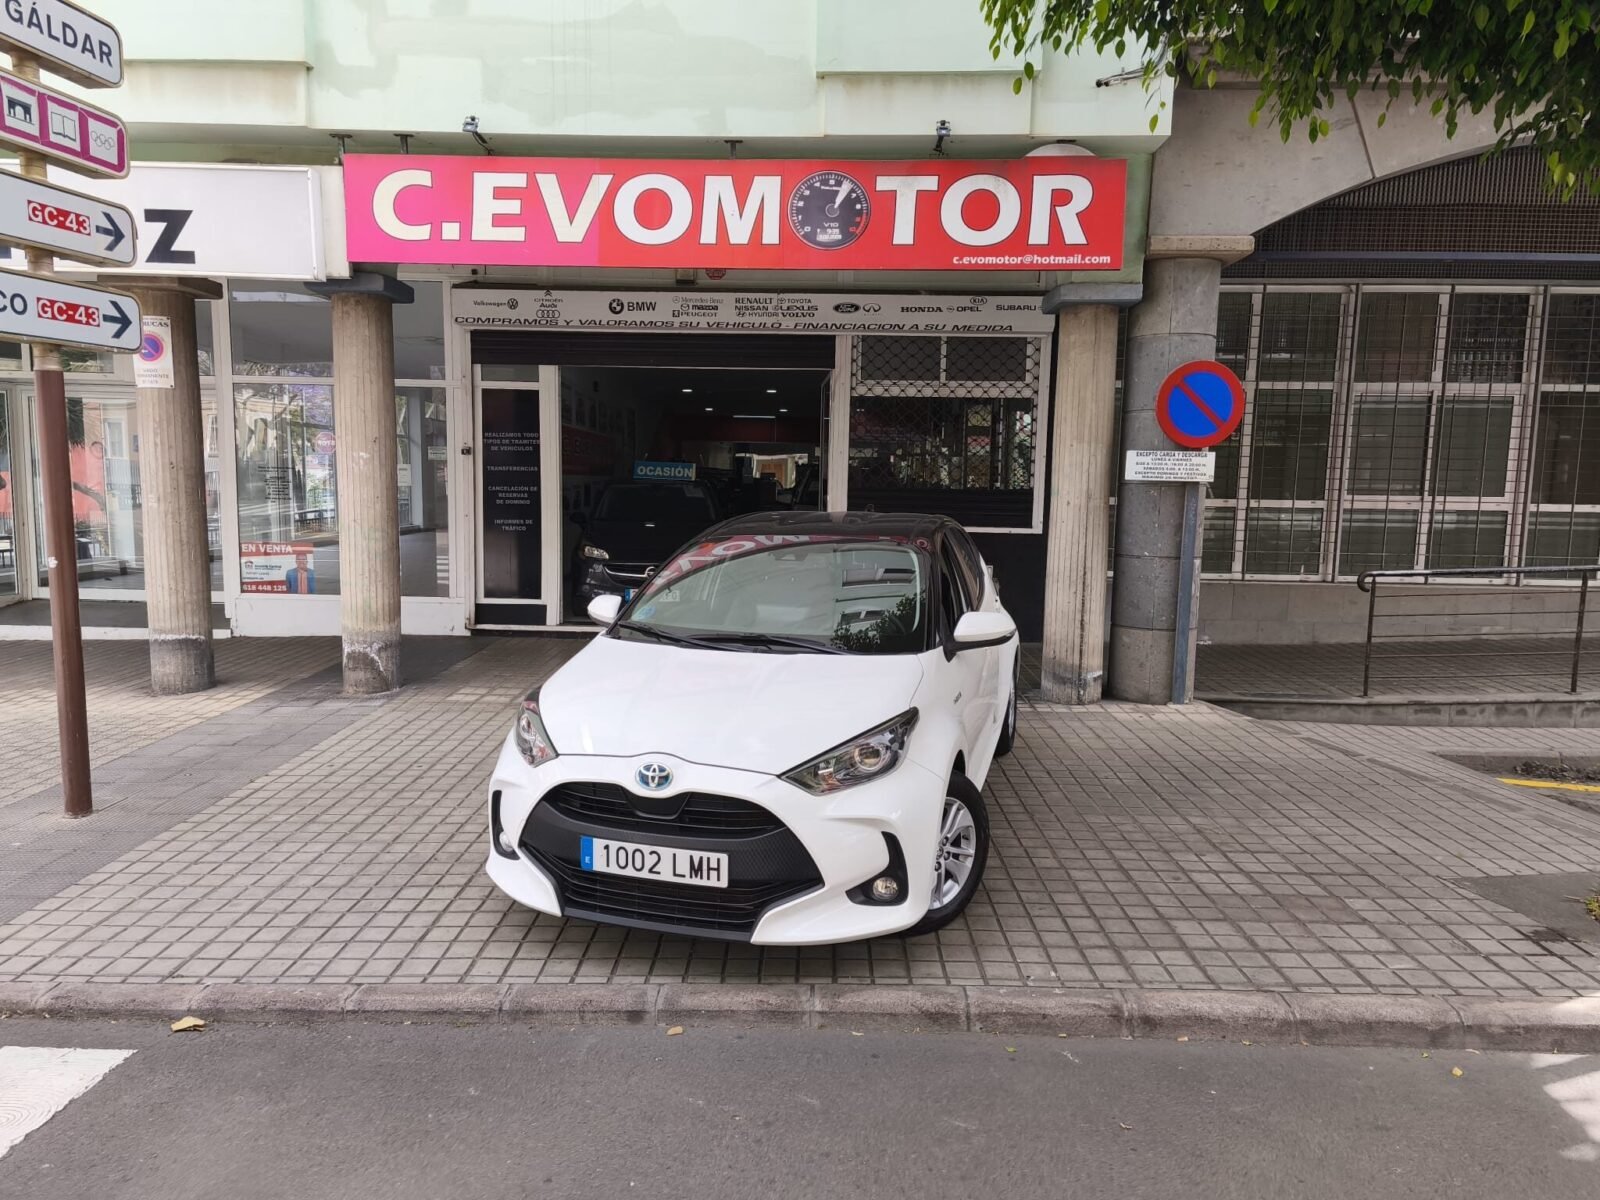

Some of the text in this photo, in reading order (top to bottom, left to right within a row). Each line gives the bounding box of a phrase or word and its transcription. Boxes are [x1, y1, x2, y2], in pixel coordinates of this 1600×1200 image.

[5, 0, 113, 67] GÁLDAR
[28, 201, 90, 235] GC-43
[953, 253, 1111, 265] c.evomotor@hotmail.com
[473, 299, 506, 308] Volkswagen
[627, 301, 657, 311] BMW
[38, 298, 100, 327] GC-43
[454, 316, 559, 326] COMPRAMOS
[578, 319, 675, 328] VALORAMOS
[679, 320, 700, 328] SU
[706, 321, 782, 329] VEHICULO
[793, 322, 905, 331] FINANCIACION
[908, 323, 920, 331] A
[923, 323, 947, 331] SU
[951, 324, 1013, 332] MEDIDA
[638, 465, 692, 477] OCASIÓN
[241, 543, 293, 553] EN VENTA
[603, 844, 661, 875] 1002
[672, 852, 721, 882] LMH
